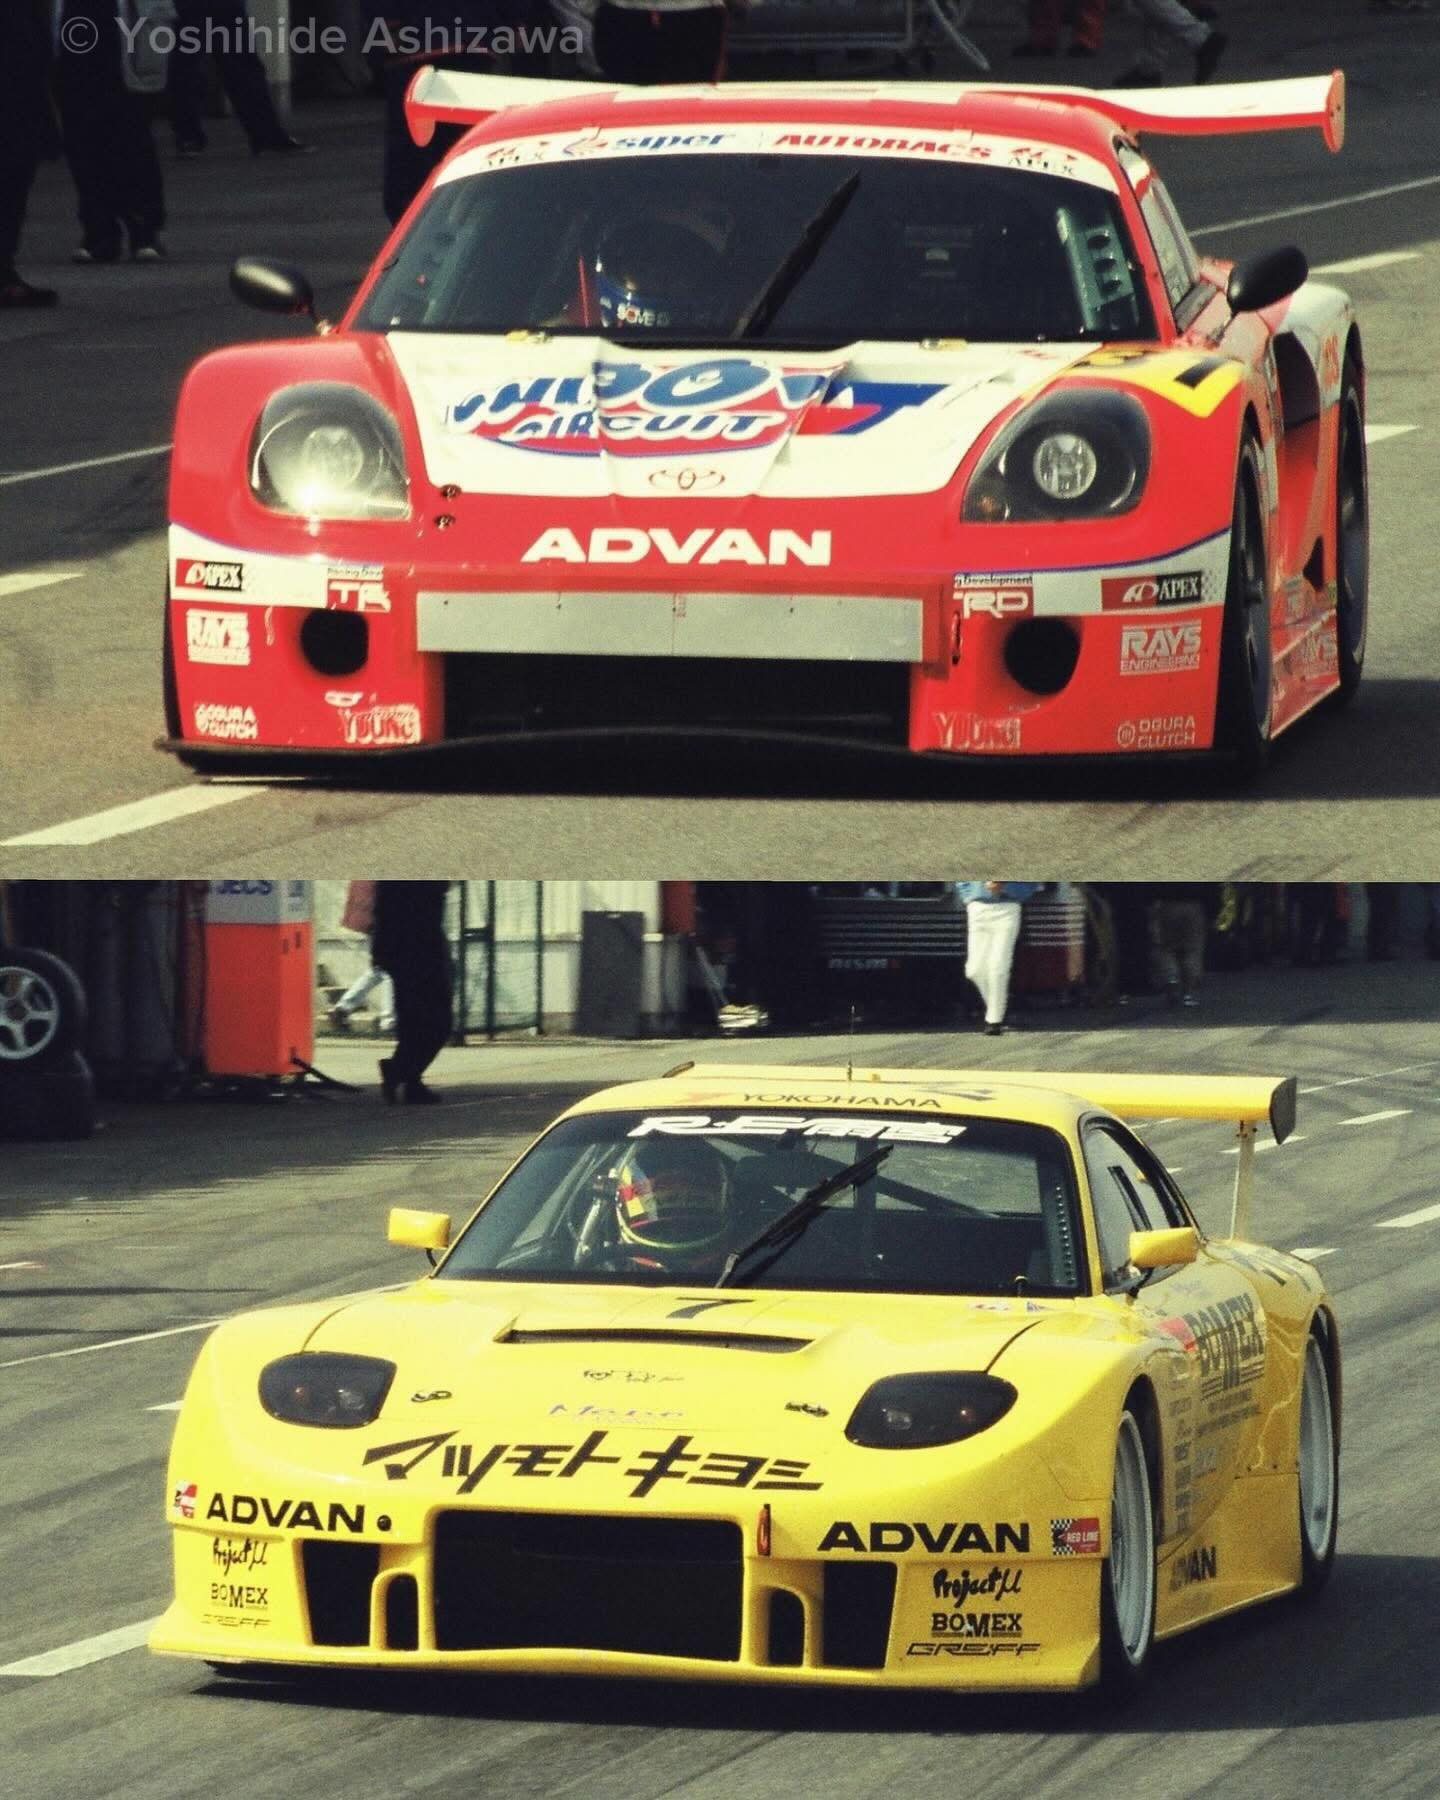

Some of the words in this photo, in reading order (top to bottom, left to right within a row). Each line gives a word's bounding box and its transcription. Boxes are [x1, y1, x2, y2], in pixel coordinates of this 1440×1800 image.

[774, 134, 993, 158] AUTOBACS
[520, 527, 832, 566] ADVAN
[1159, 576, 1199, 601] APEX
[1121, 626, 1201, 660] RAYS
[743, 1093, 941, 1109] YOKOHAMA
[666, 1296, 756, 1319] 7
[206, 1492, 365, 1533] ADVAN
[817, 1520, 1030, 1553] ADVAN
[210, 1582, 268, 1608] BOMEX
[932, 1566, 1001, 1608] Project
[931, 1612, 1023, 1637] BOMEX
